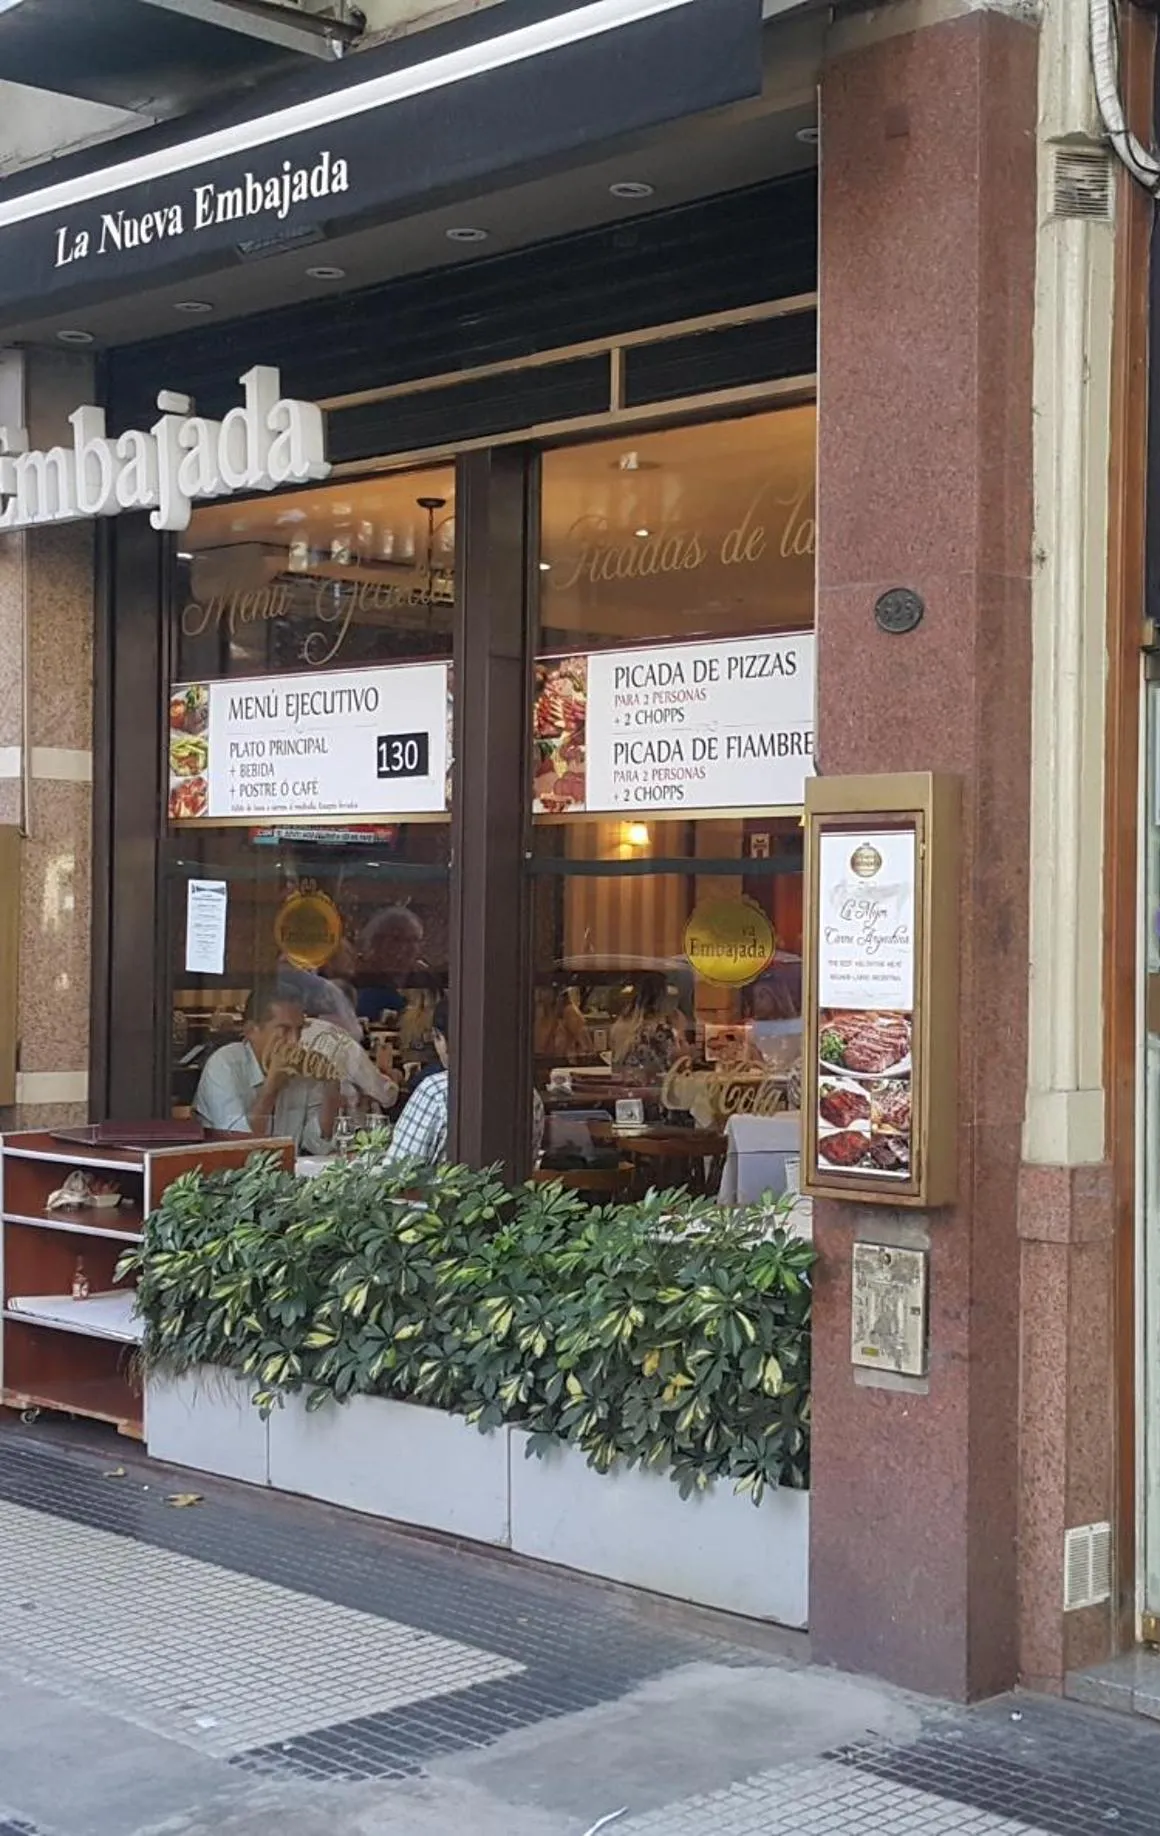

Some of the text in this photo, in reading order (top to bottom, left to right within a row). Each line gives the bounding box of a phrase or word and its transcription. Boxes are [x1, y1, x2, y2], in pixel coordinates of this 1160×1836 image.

[54, 151, 349, 267] La Nueva Embajada
[720, 478, 766, 566] de
[614, 651, 798, 690] PICADA DE PIZZAS
[227, 686, 380, 722] MENÚ EJECUTIVO
[614, 687, 707, 708] PARA 2 PERSONAS
[624, 711, 632, 727] 2
[634, 706, 686, 726] CHOPPS
[229, 736, 329, 759] PLATO PRINCIPAL
[377, 740, 419, 772] 130
[613, 738, 685, 766] PICADA
[692, 737, 719, 762] DE
[239, 762, 275, 778] BEBIDA
[613, 766, 707, 785] PARA 2 PERSONAS
[239, 781, 278, 798] POSTRE
[623, 788, 631, 802] 2
[633, 784, 685, 802] CHOPPS
